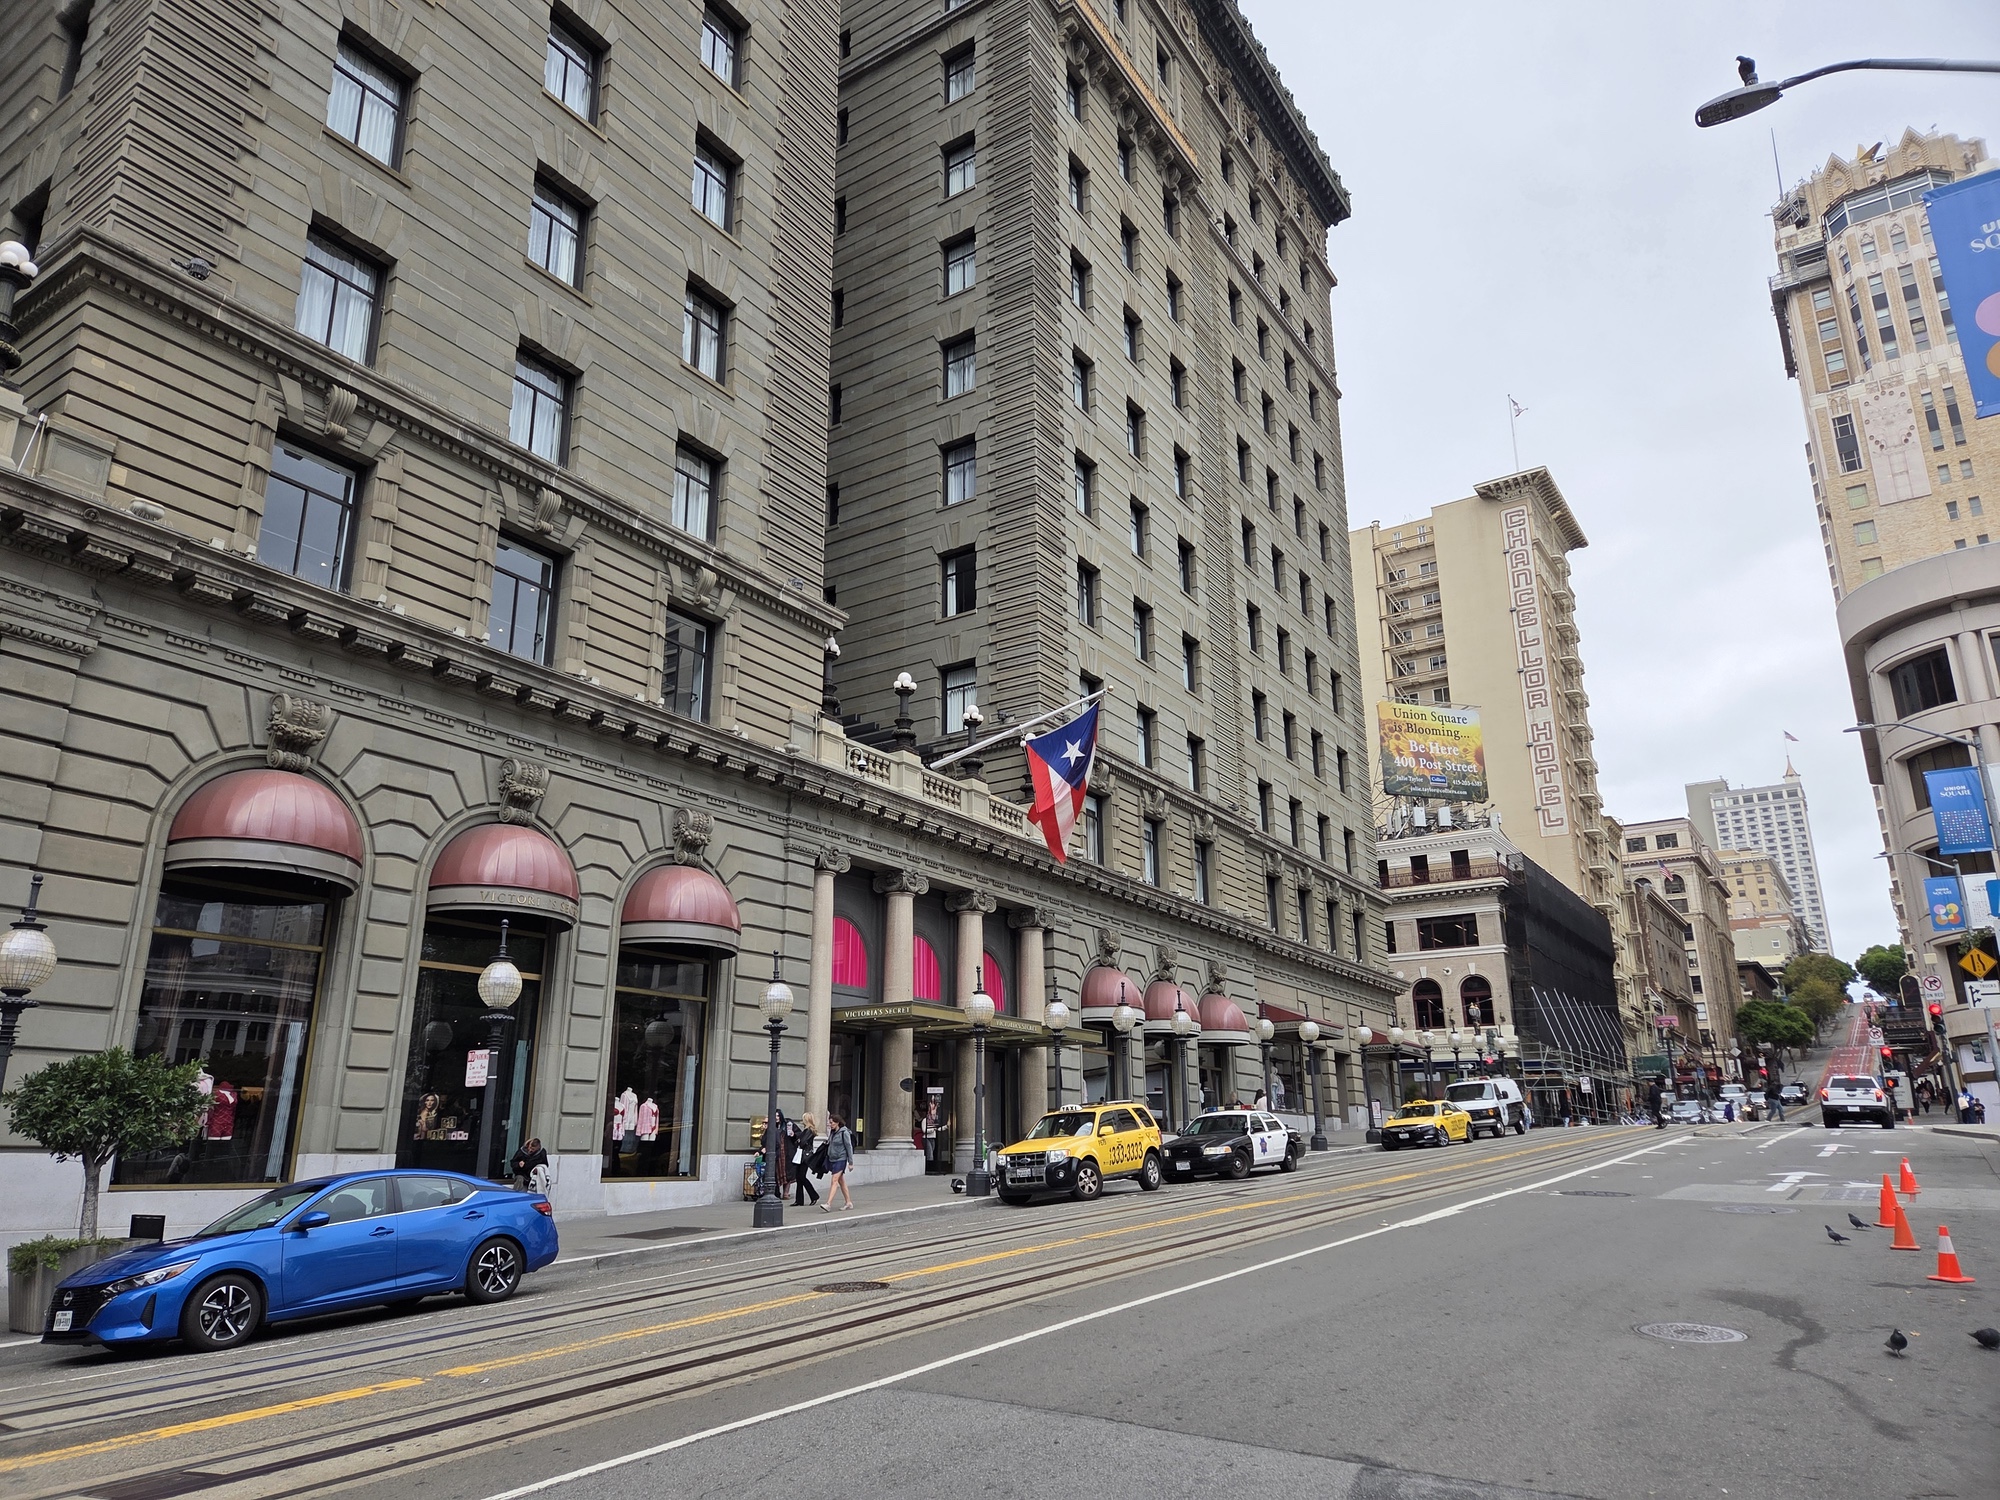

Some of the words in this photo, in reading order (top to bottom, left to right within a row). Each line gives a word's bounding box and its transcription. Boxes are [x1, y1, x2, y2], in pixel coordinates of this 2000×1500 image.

[1504, 508, 1549, 710] CHANCELLOR
[1530, 720, 1564, 828] HOTEL
[1393, 707, 1427, 721] Union
[1430, 711, 1468, 726] Square
[1393, 721, 1403, 732] is
[1406, 722, 1470, 741] Blooming...
[1408, 739, 1426, 753] Be
[1429, 741, 1460, 756] Here
[1393, 756, 1416, 768] 400
[1419, 757, 1443, 770] Post
[1445, 760, 1479, 773] Street
[1940, 789, 1972, 798] SQUARE
[844, 1008, 883, 1018] VICTORIA'S
[885, 1006, 910, 1015] SECRET
